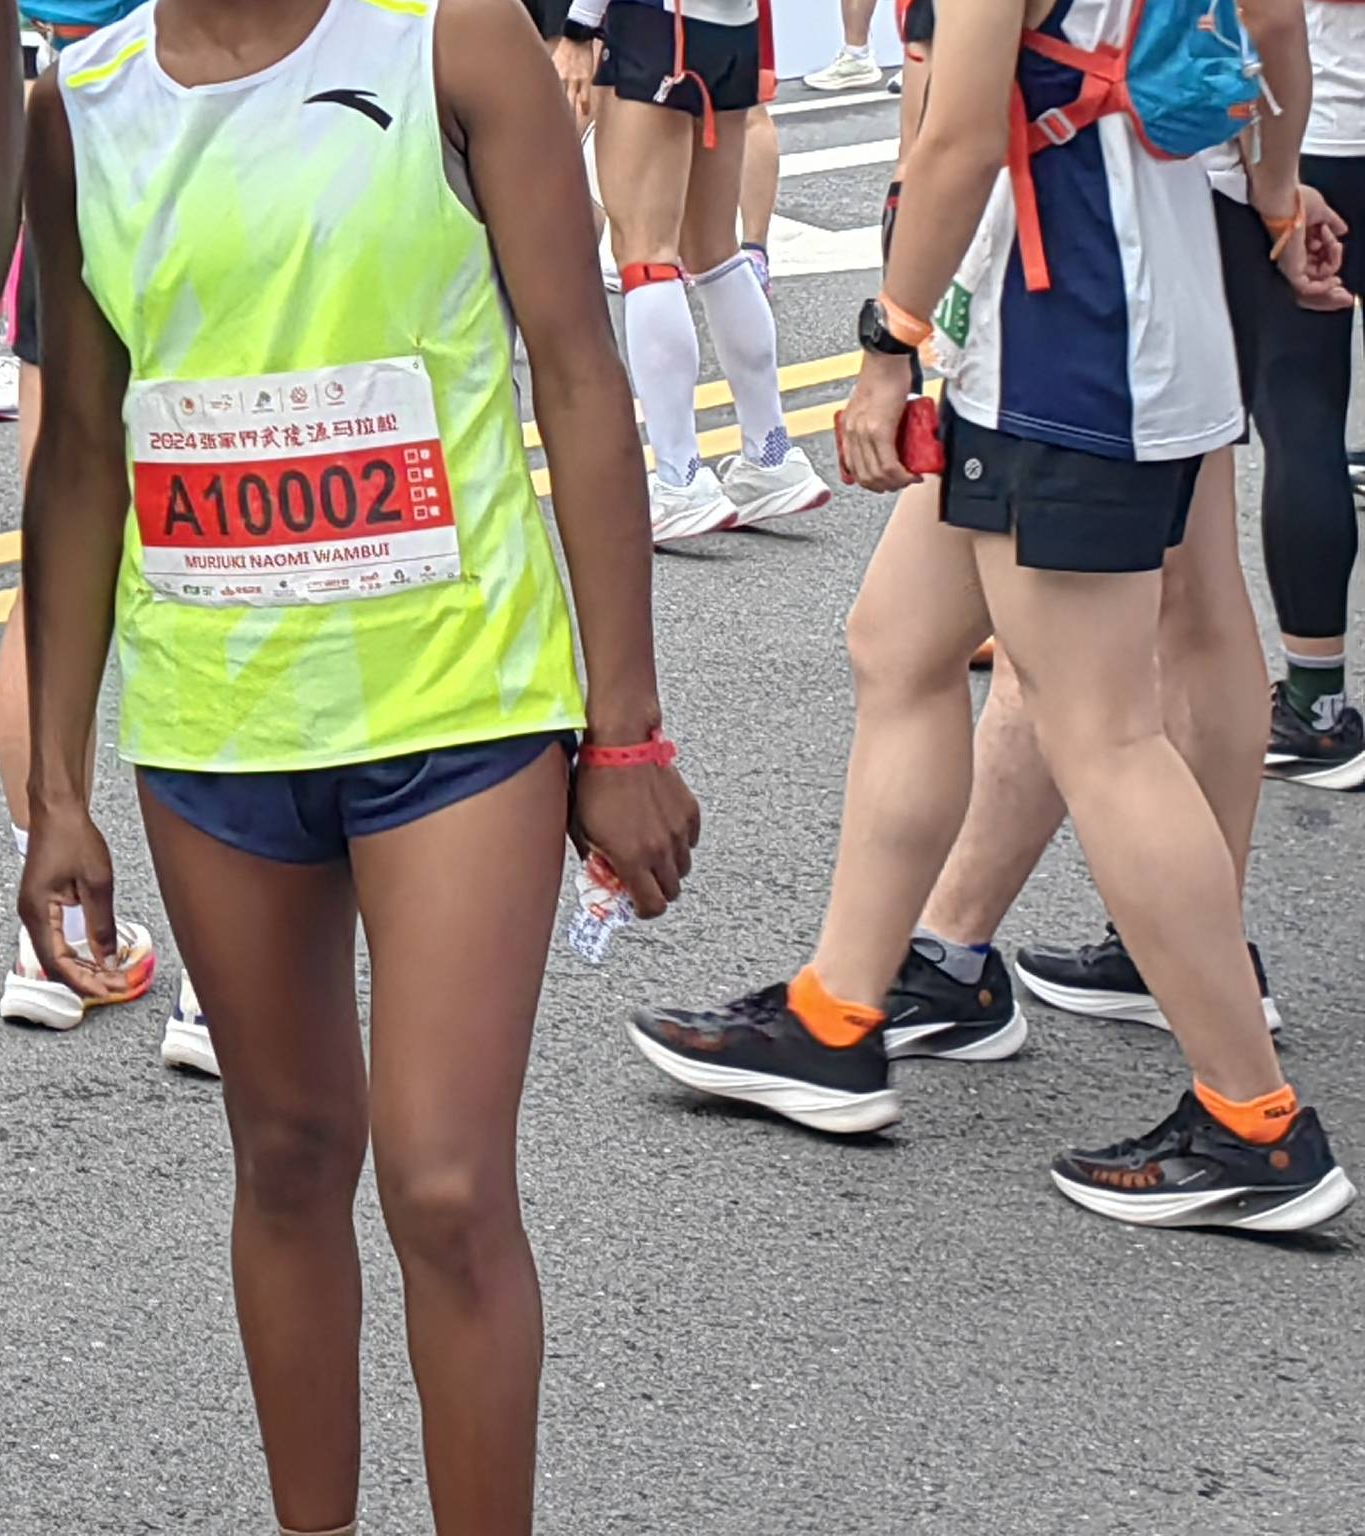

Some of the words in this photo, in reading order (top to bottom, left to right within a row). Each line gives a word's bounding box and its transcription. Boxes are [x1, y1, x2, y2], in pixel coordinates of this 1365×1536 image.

[148, 412, 399, 451] 2024张家界武陵源马拉松
[163, 458, 403, 537] A10002
[250, 550, 310, 569] NAOMI
[313, 542, 390, 563] WAMBUI
